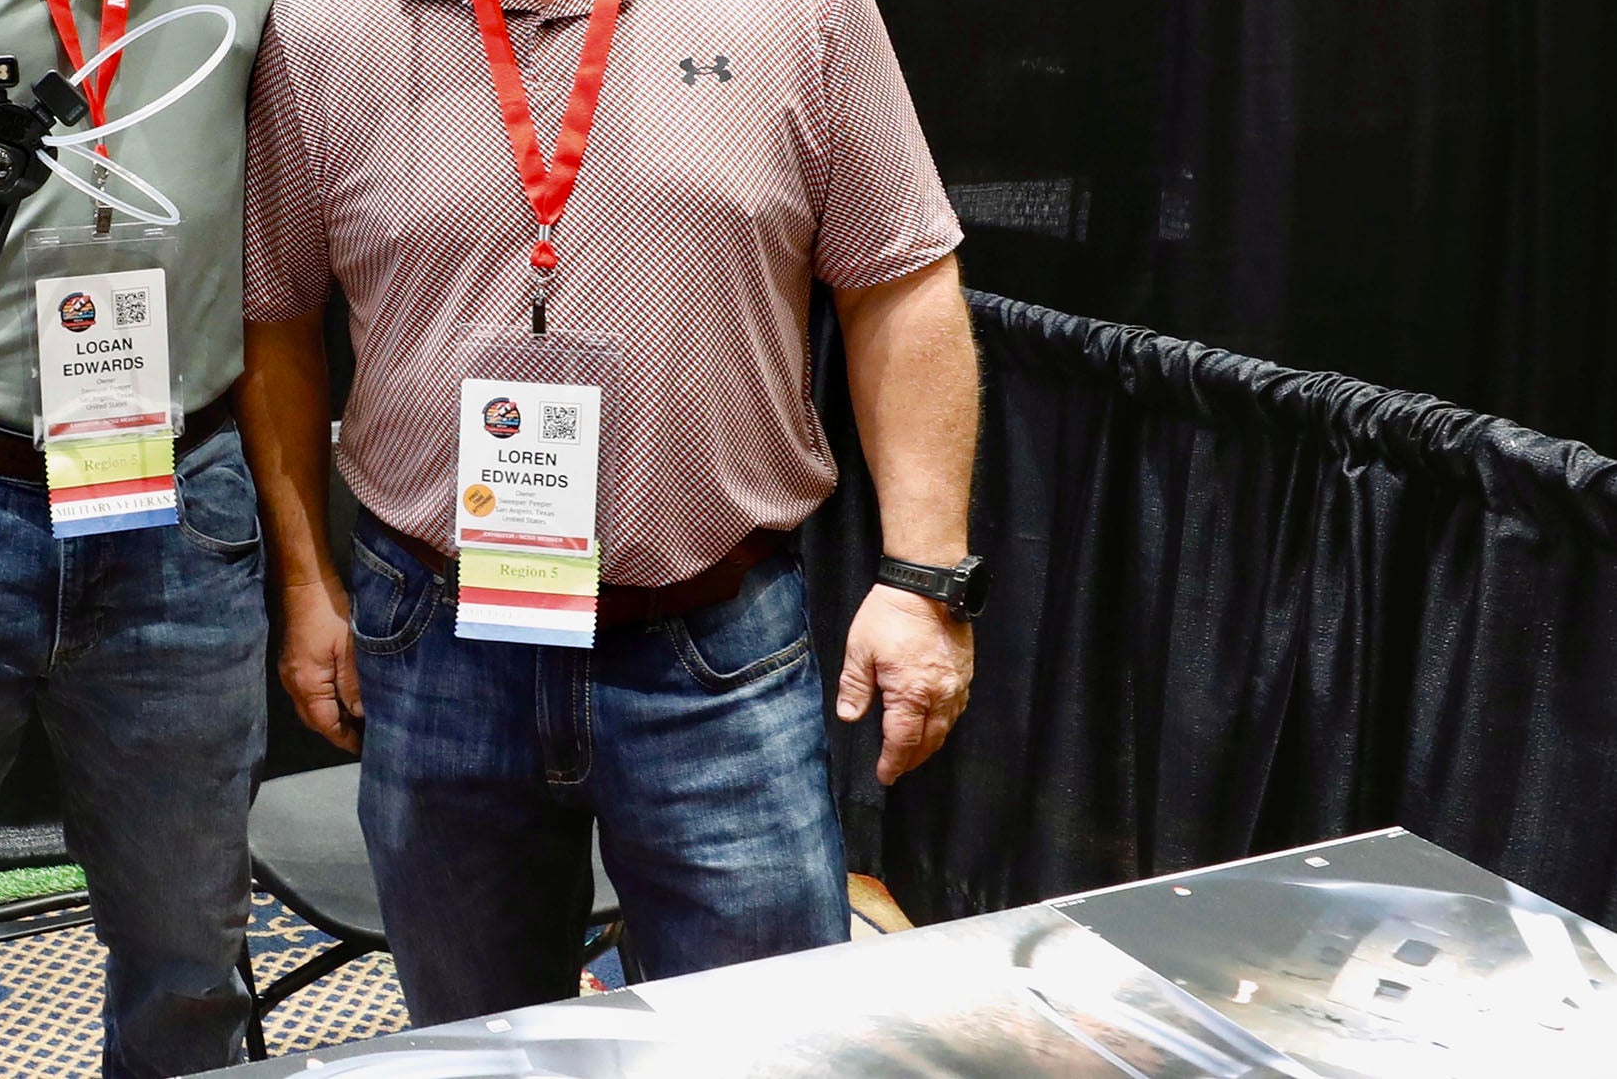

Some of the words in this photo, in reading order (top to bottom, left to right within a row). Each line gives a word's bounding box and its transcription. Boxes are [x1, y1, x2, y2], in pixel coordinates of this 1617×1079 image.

[76, 338, 133, 355] LOGAN
[63, 356, 144, 377] EDWARDS
[83, 457, 127, 472] Region
[498, 449, 557, 466] LOREN
[481, 469, 569, 488] EDWARDS
[500, 563, 546, 578] Region
[550, 567, 559, 578] 5
